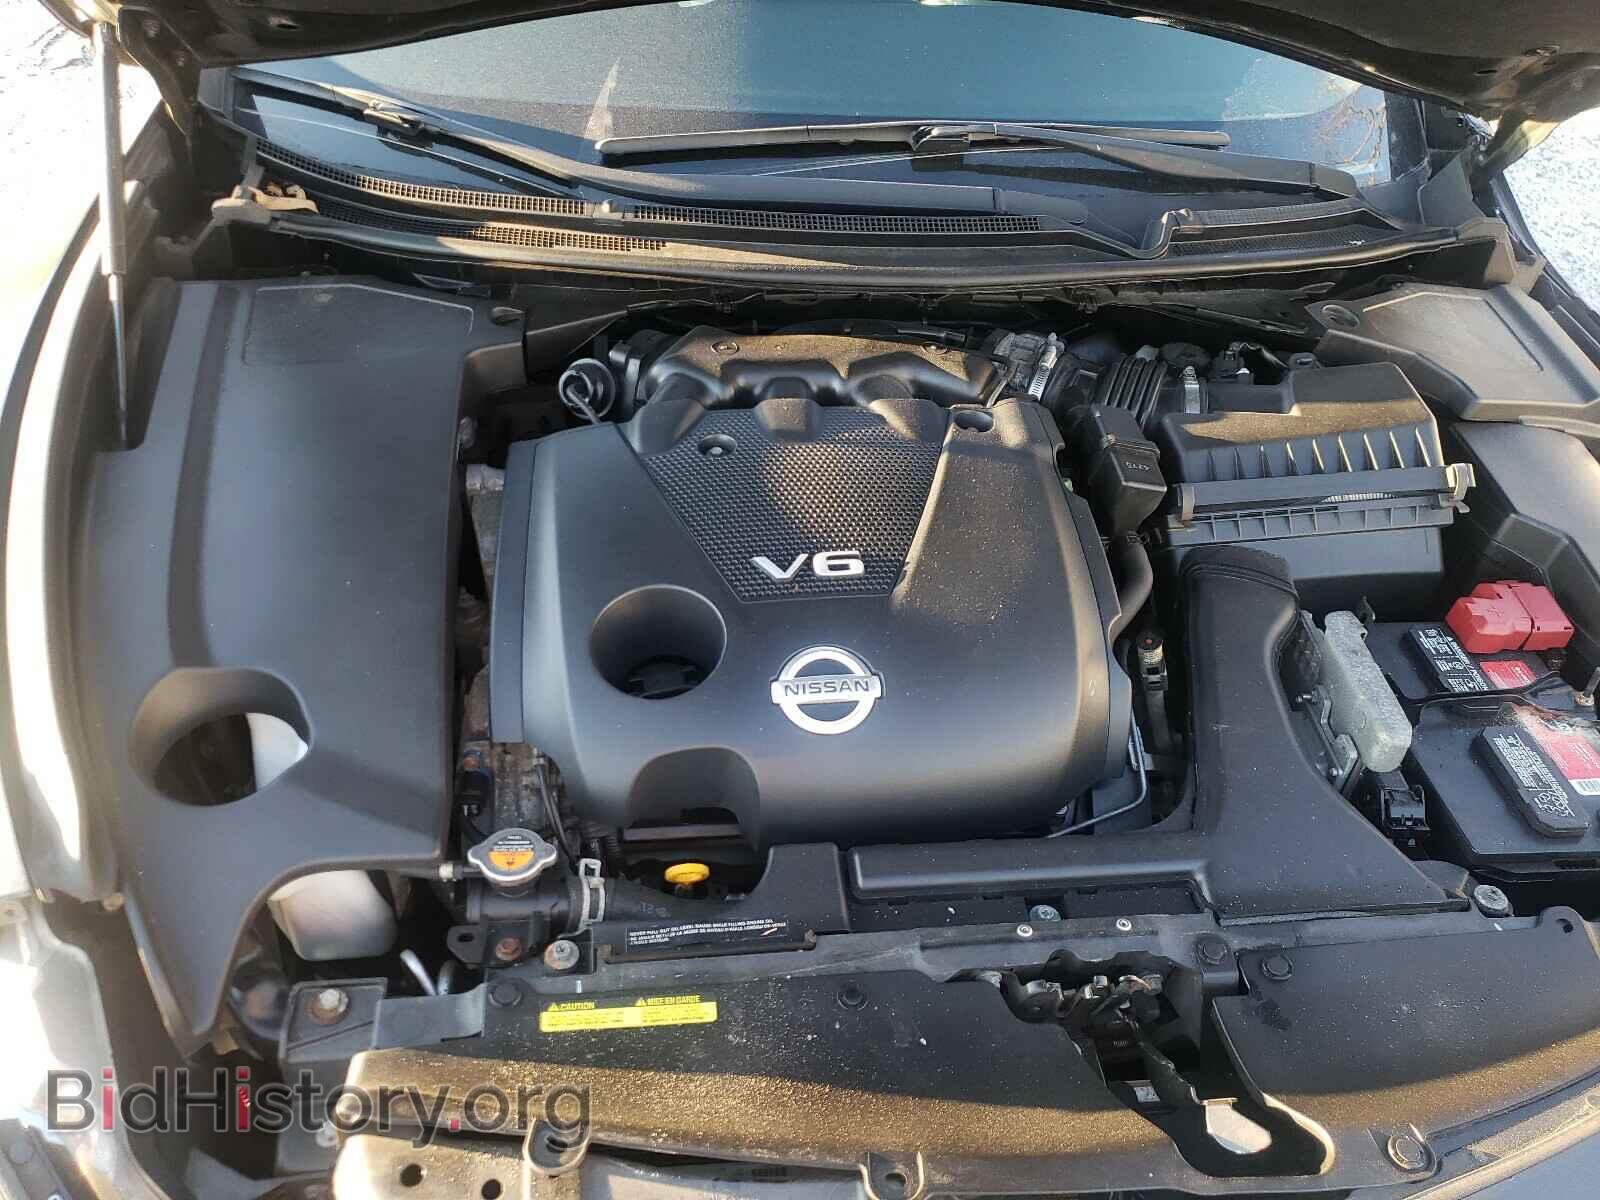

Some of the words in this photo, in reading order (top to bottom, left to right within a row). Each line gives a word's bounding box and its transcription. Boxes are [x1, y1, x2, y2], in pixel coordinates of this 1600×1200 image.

[751, 550, 865, 582] V6
[784, 679, 870, 697] NISSAN
[560, 1002, 595, 1010] CAUTION
[648, 997, 664, 1006] MISE
[665, 996, 675, 1005] EN
[676, 994, 700, 1004] GARDE
